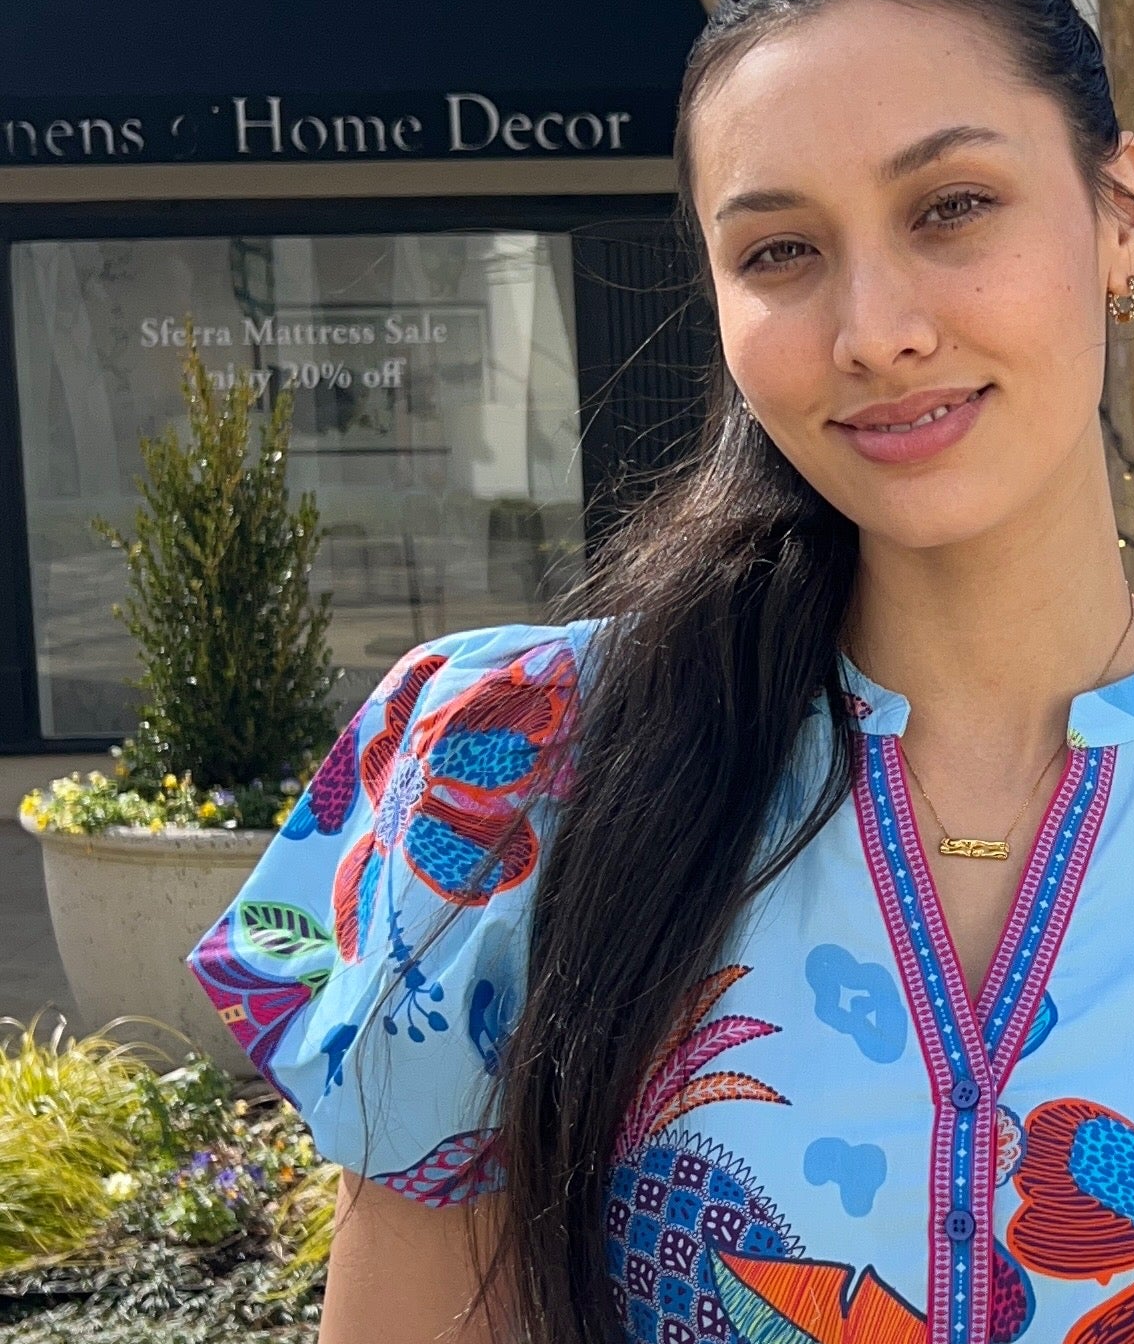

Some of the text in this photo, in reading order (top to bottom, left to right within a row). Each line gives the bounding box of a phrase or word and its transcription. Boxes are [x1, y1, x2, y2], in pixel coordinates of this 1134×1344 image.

[233, 96, 423, 152] Home
[445, 92, 631, 151] Decor
[242, 316, 376, 346] Mattress
[385, 313, 448, 345] Sale
[363, 357, 407, 389] off
